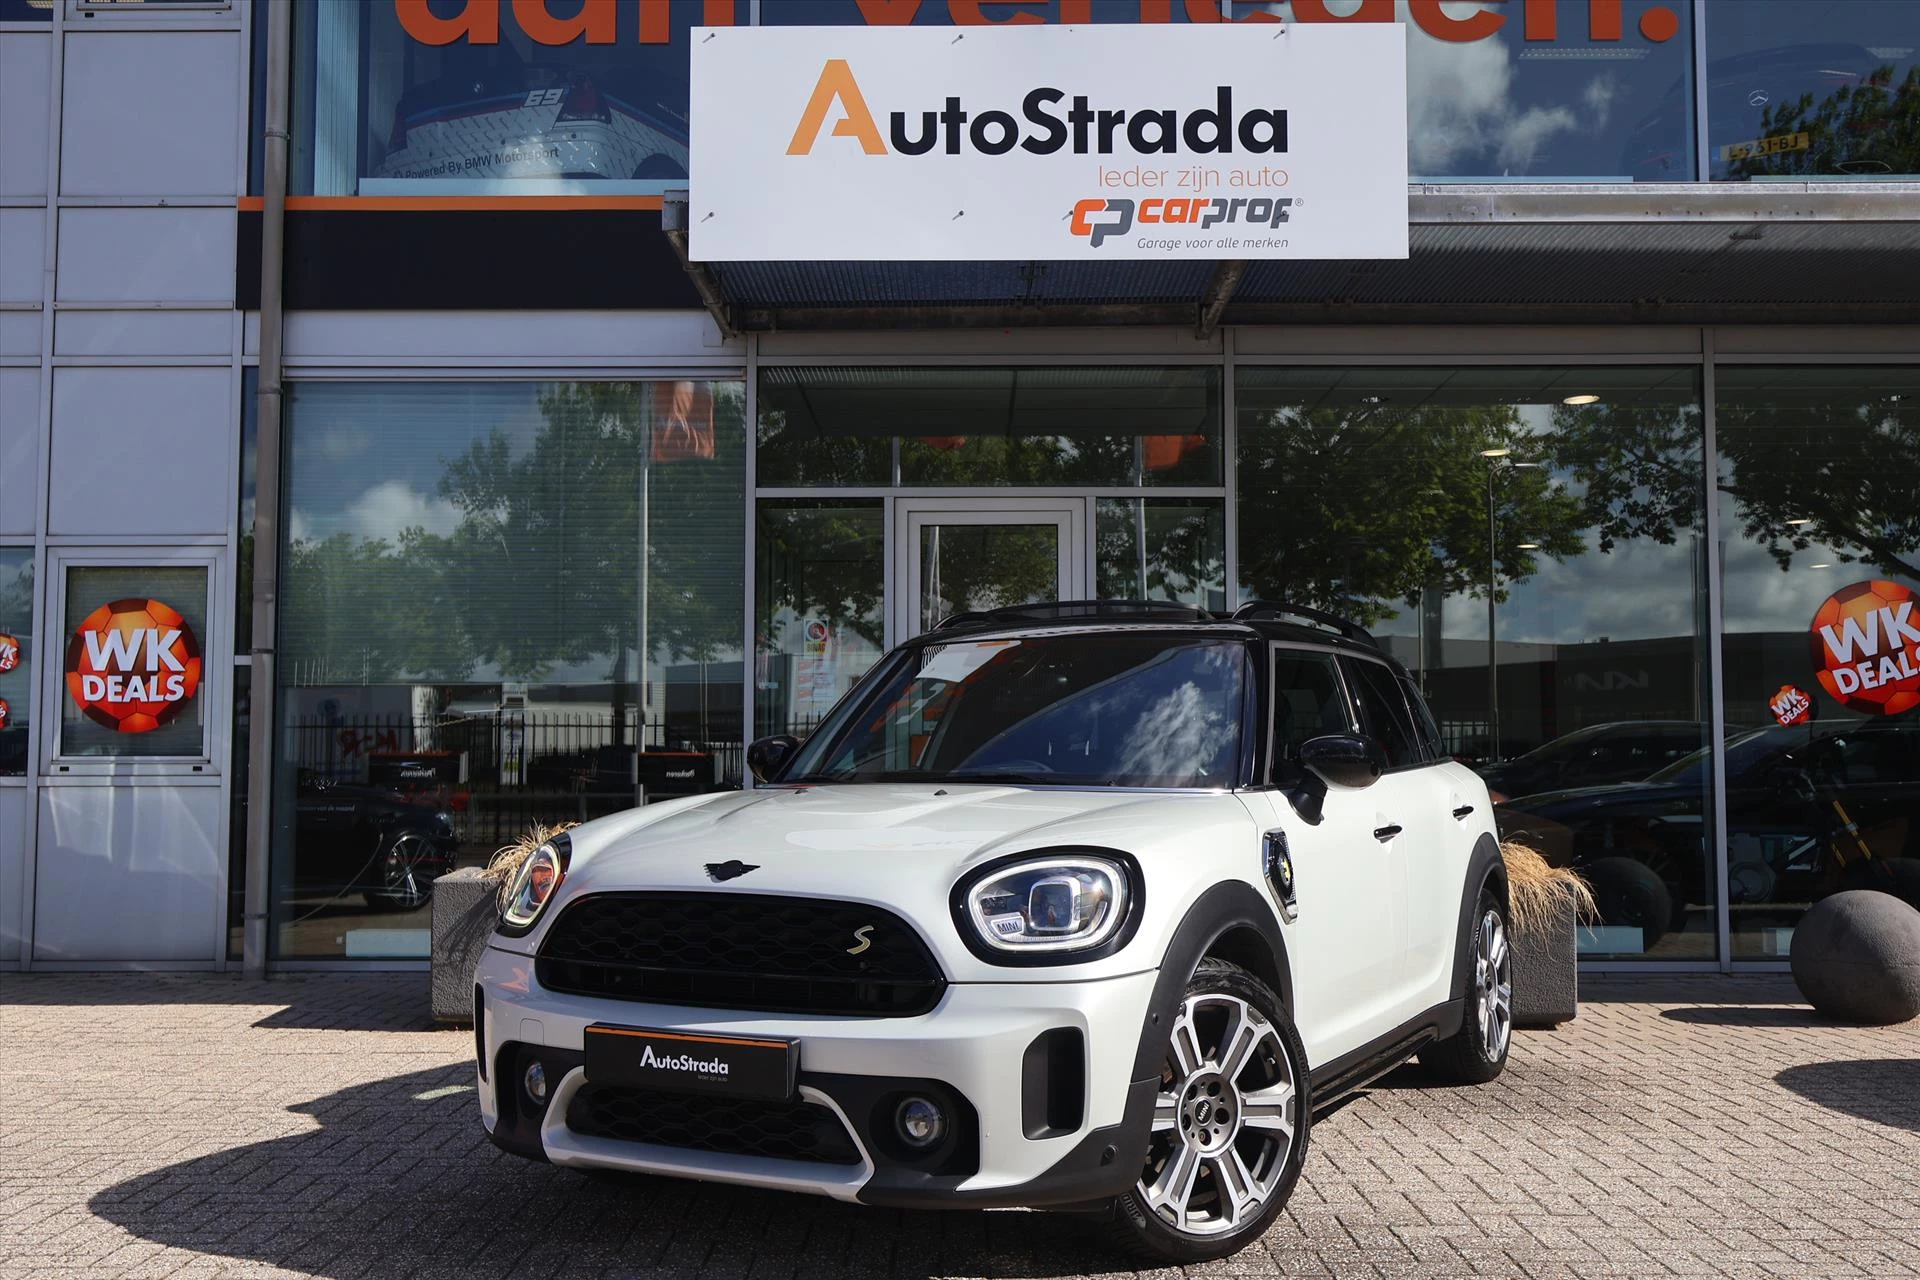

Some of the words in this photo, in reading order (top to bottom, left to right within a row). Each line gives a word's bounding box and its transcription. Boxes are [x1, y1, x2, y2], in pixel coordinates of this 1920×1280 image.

[524, 87, 564, 107] 69
[785, 59, 1289, 156] AutoStrada
[448, 161, 463, 175] By
[464, 154, 492, 170] BMW
[494, 146, 560, 165] Motorsport
[1099, 165, 1169, 188] Ieder
[1177, 165, 1220, 192] zijn
[1229, 165, 1289, 188] auto
[1137, 237, 1182, 251] Garage
[1185, 239, 1214, 249] voor
[1216, 237, 1240, 249] alle
[1243, 237, 1289, 249] merken
[1819, 601, 1920, 664] WK
[84, 628, 186, 672] WK
[1832, 645, 1920, 695] DEAL
[82, 674, 185, 703] DEALS
[1771, 688, 1804, 716] WK
[1780, 698, 1809, 724] DEALS
[846, 925, 874, 955] S
[996, 920, 1019, 933] MINI
[640, 1045, 729, 1075] AutoStrada
[1198, 1102, 1210, 1121] MINI
